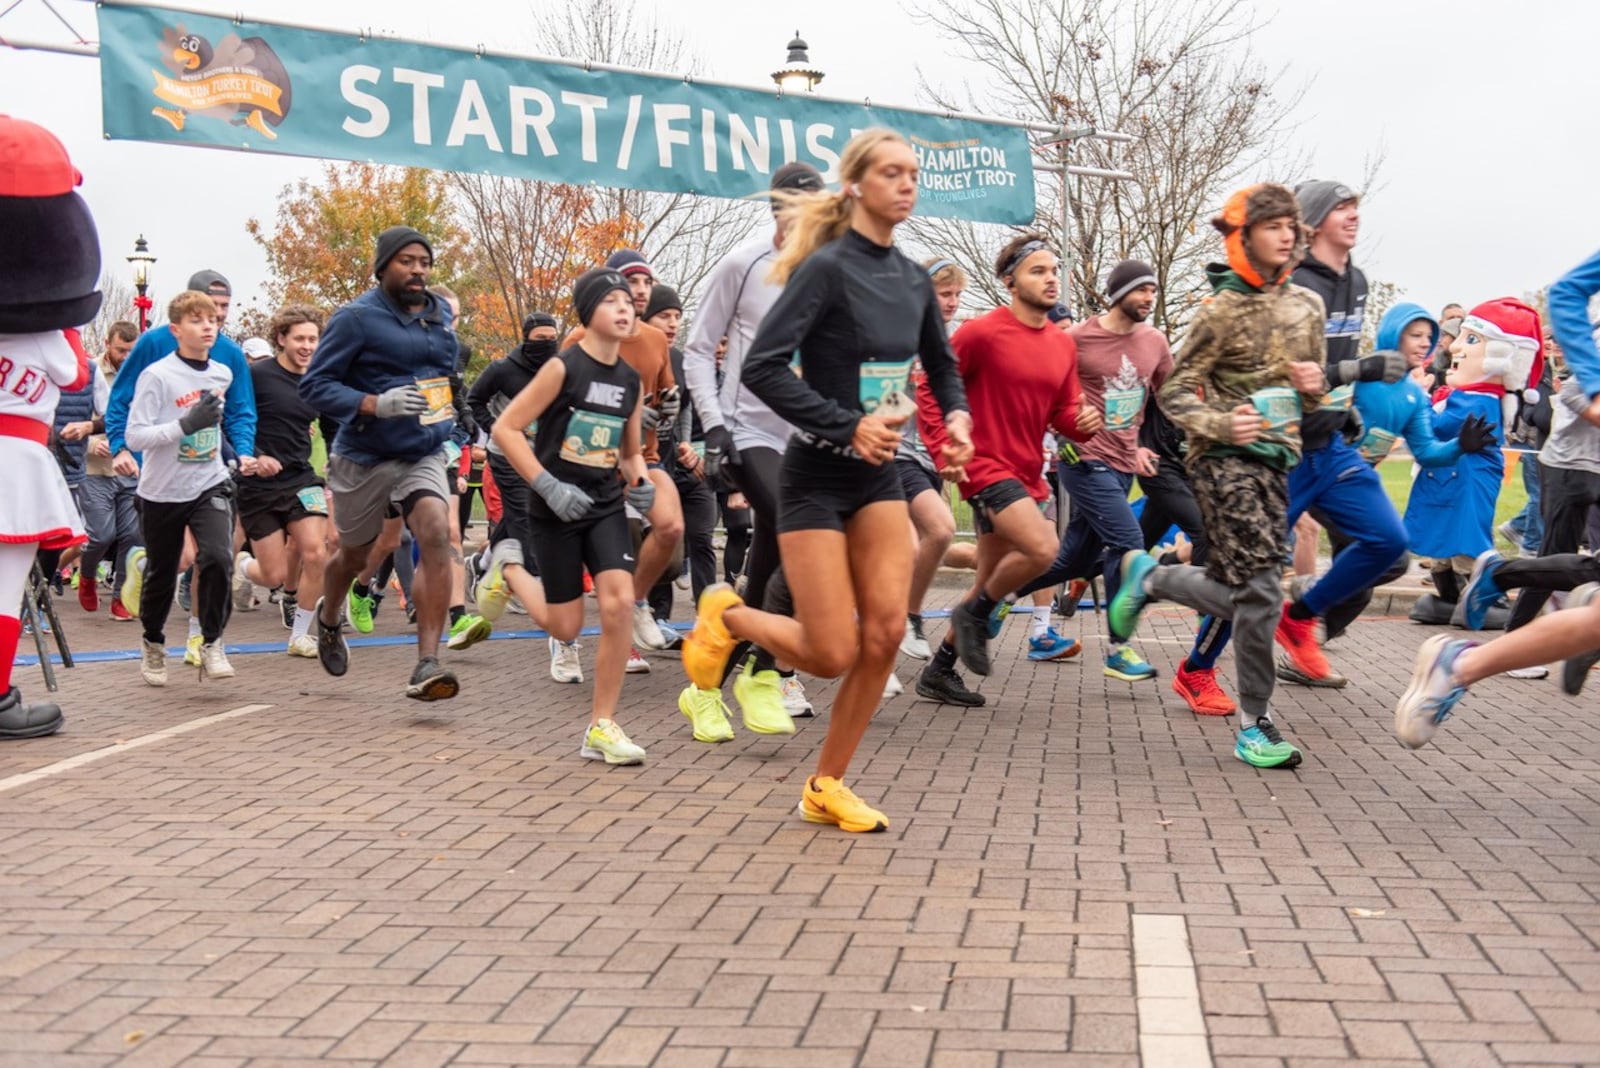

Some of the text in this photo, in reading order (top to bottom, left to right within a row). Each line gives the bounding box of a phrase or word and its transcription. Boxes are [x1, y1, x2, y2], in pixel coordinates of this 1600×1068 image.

[211, 77, 247, 95] TURKEY
[250, 79, 274, 99] TROT
[339, 63, 868, 185] START/FINIS
[911, 143, 1007, 172] HAMILTON
[975, 169, 1017, 187] TROT
[934, 187, 987, 203] YOUNGLIVES
[0, 356, 47, 404] RED
[583, 381, 626, 409] NIKE
[590, 425, 611, 448] 80
